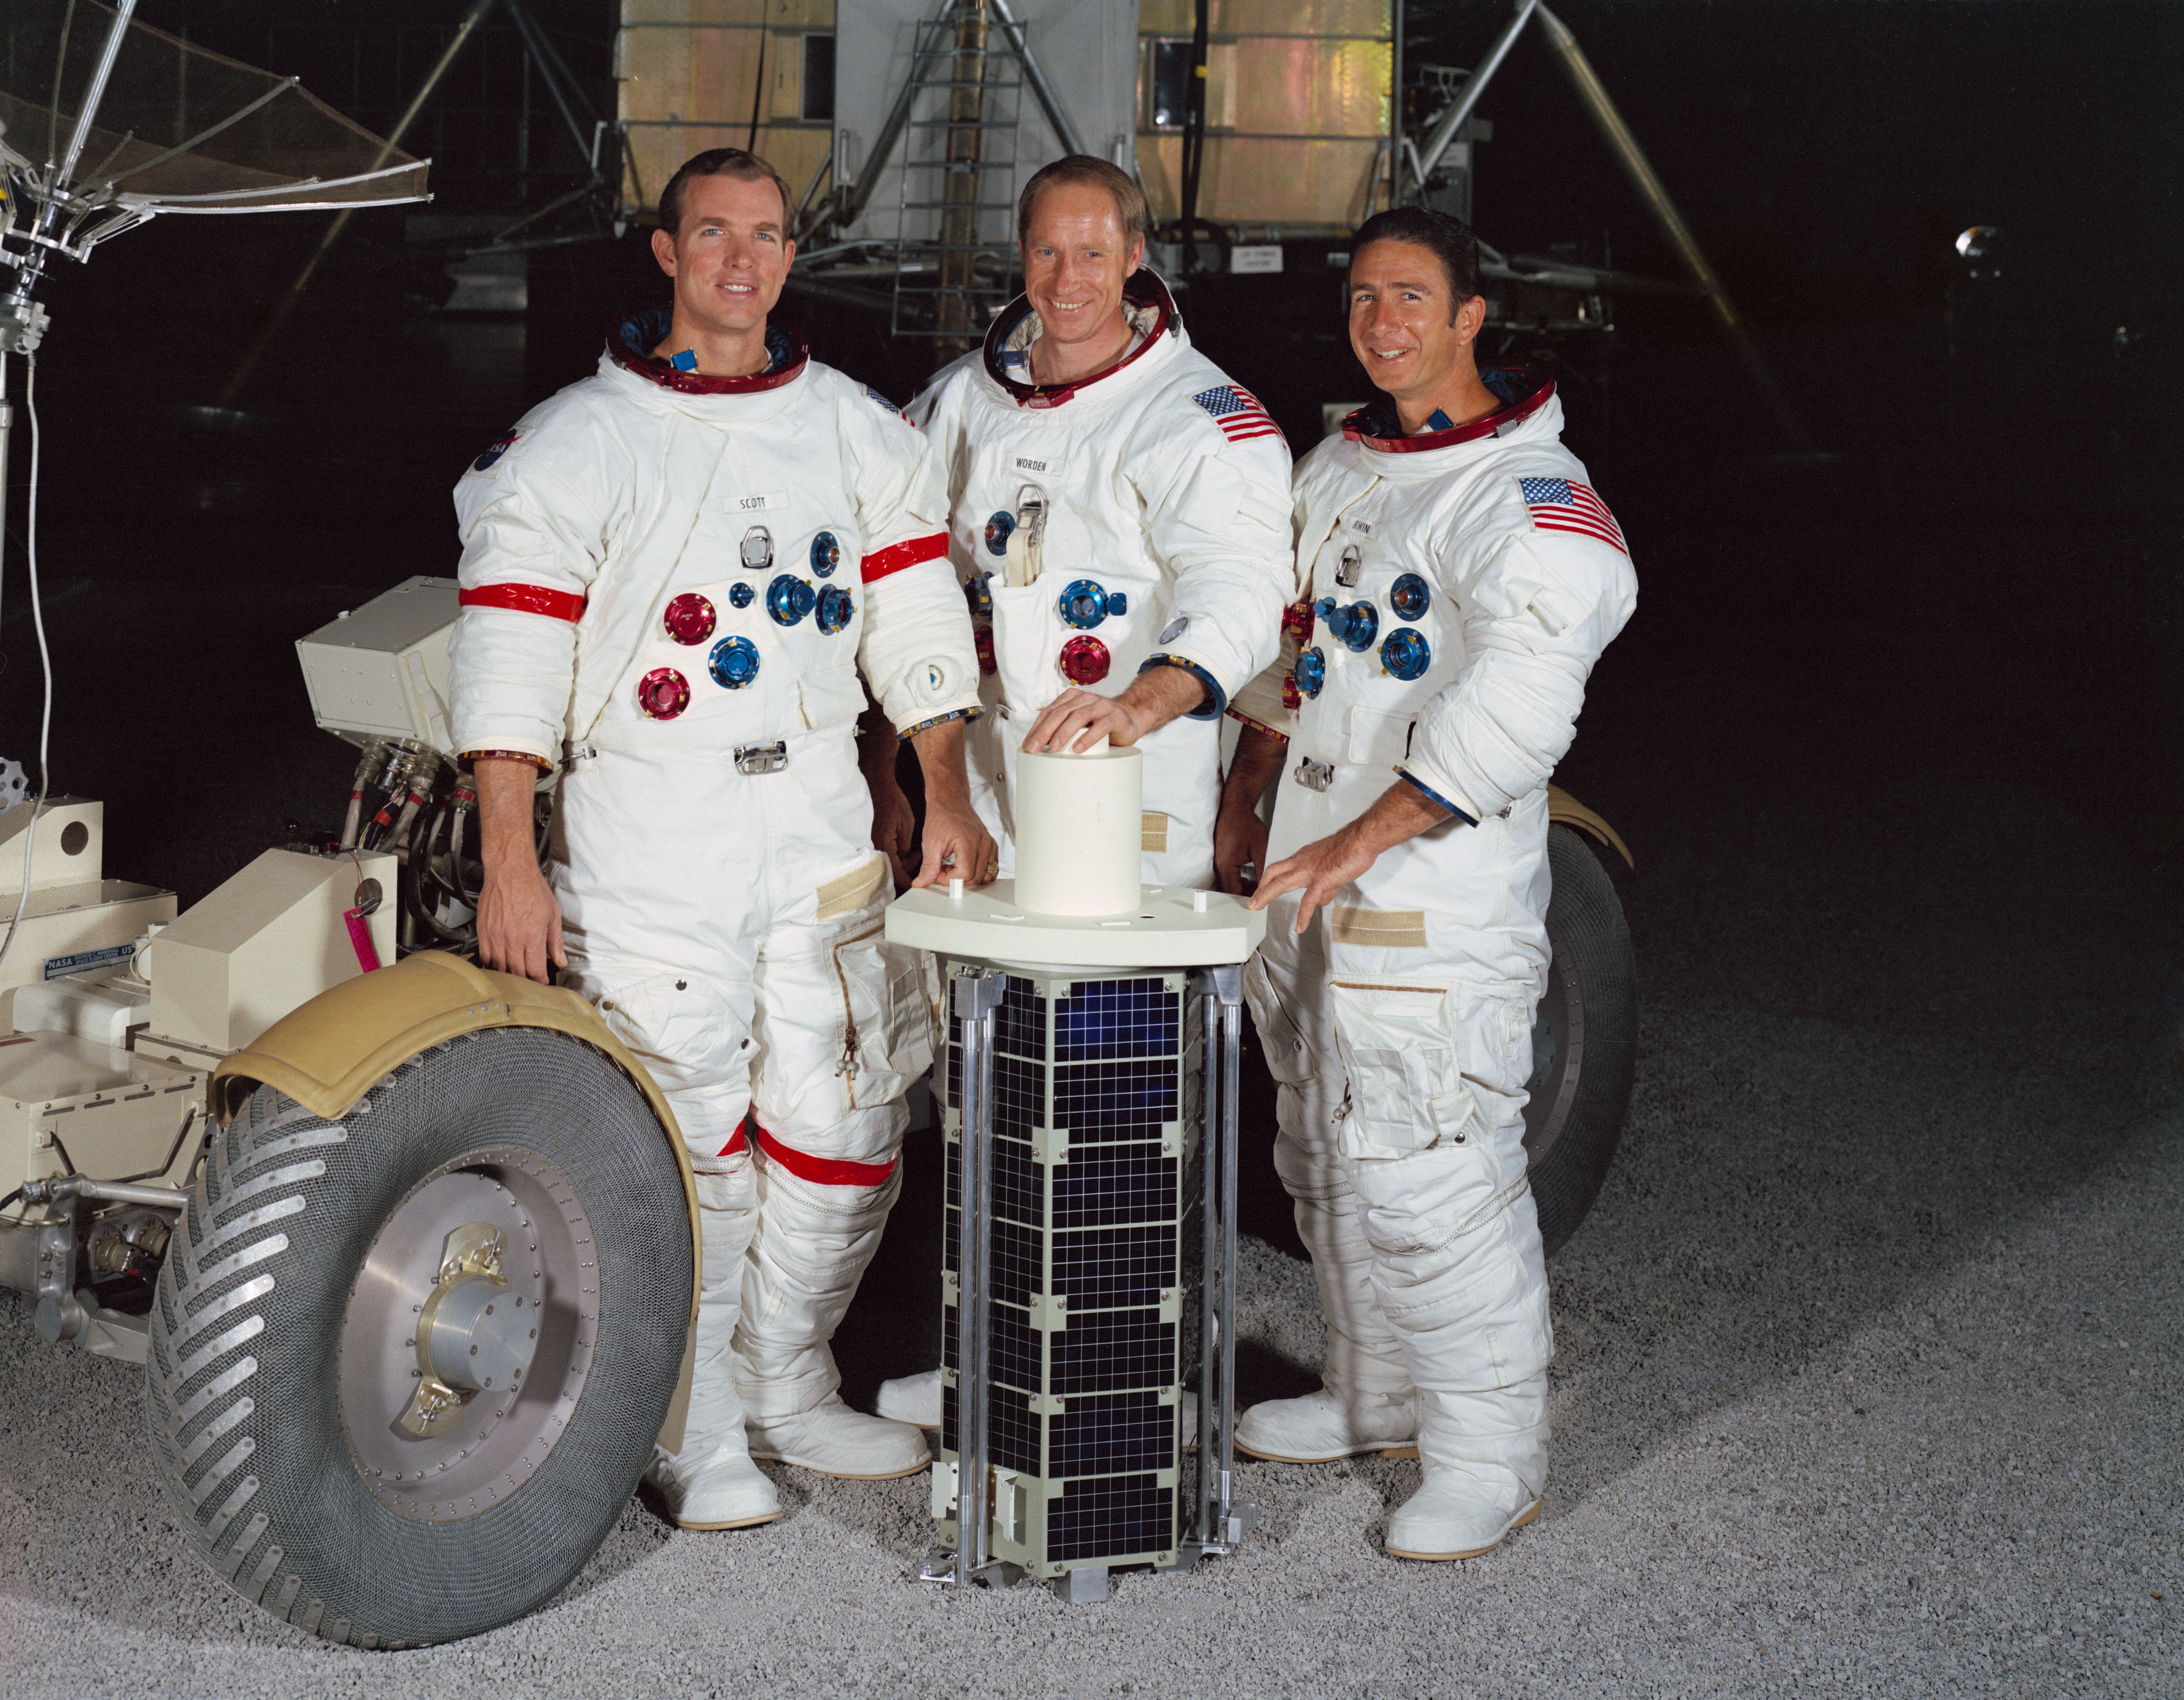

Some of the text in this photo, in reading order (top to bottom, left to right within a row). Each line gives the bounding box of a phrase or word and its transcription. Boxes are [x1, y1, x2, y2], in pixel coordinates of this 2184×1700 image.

[1016, 457, 1047, 471] WORDEN
[740, 497, 765, 509] SCOTT
[1352, 520, 1371, 534] IRWIN
[122, 946, 132, 954] US
[49, 958, 72, 969] NASA
